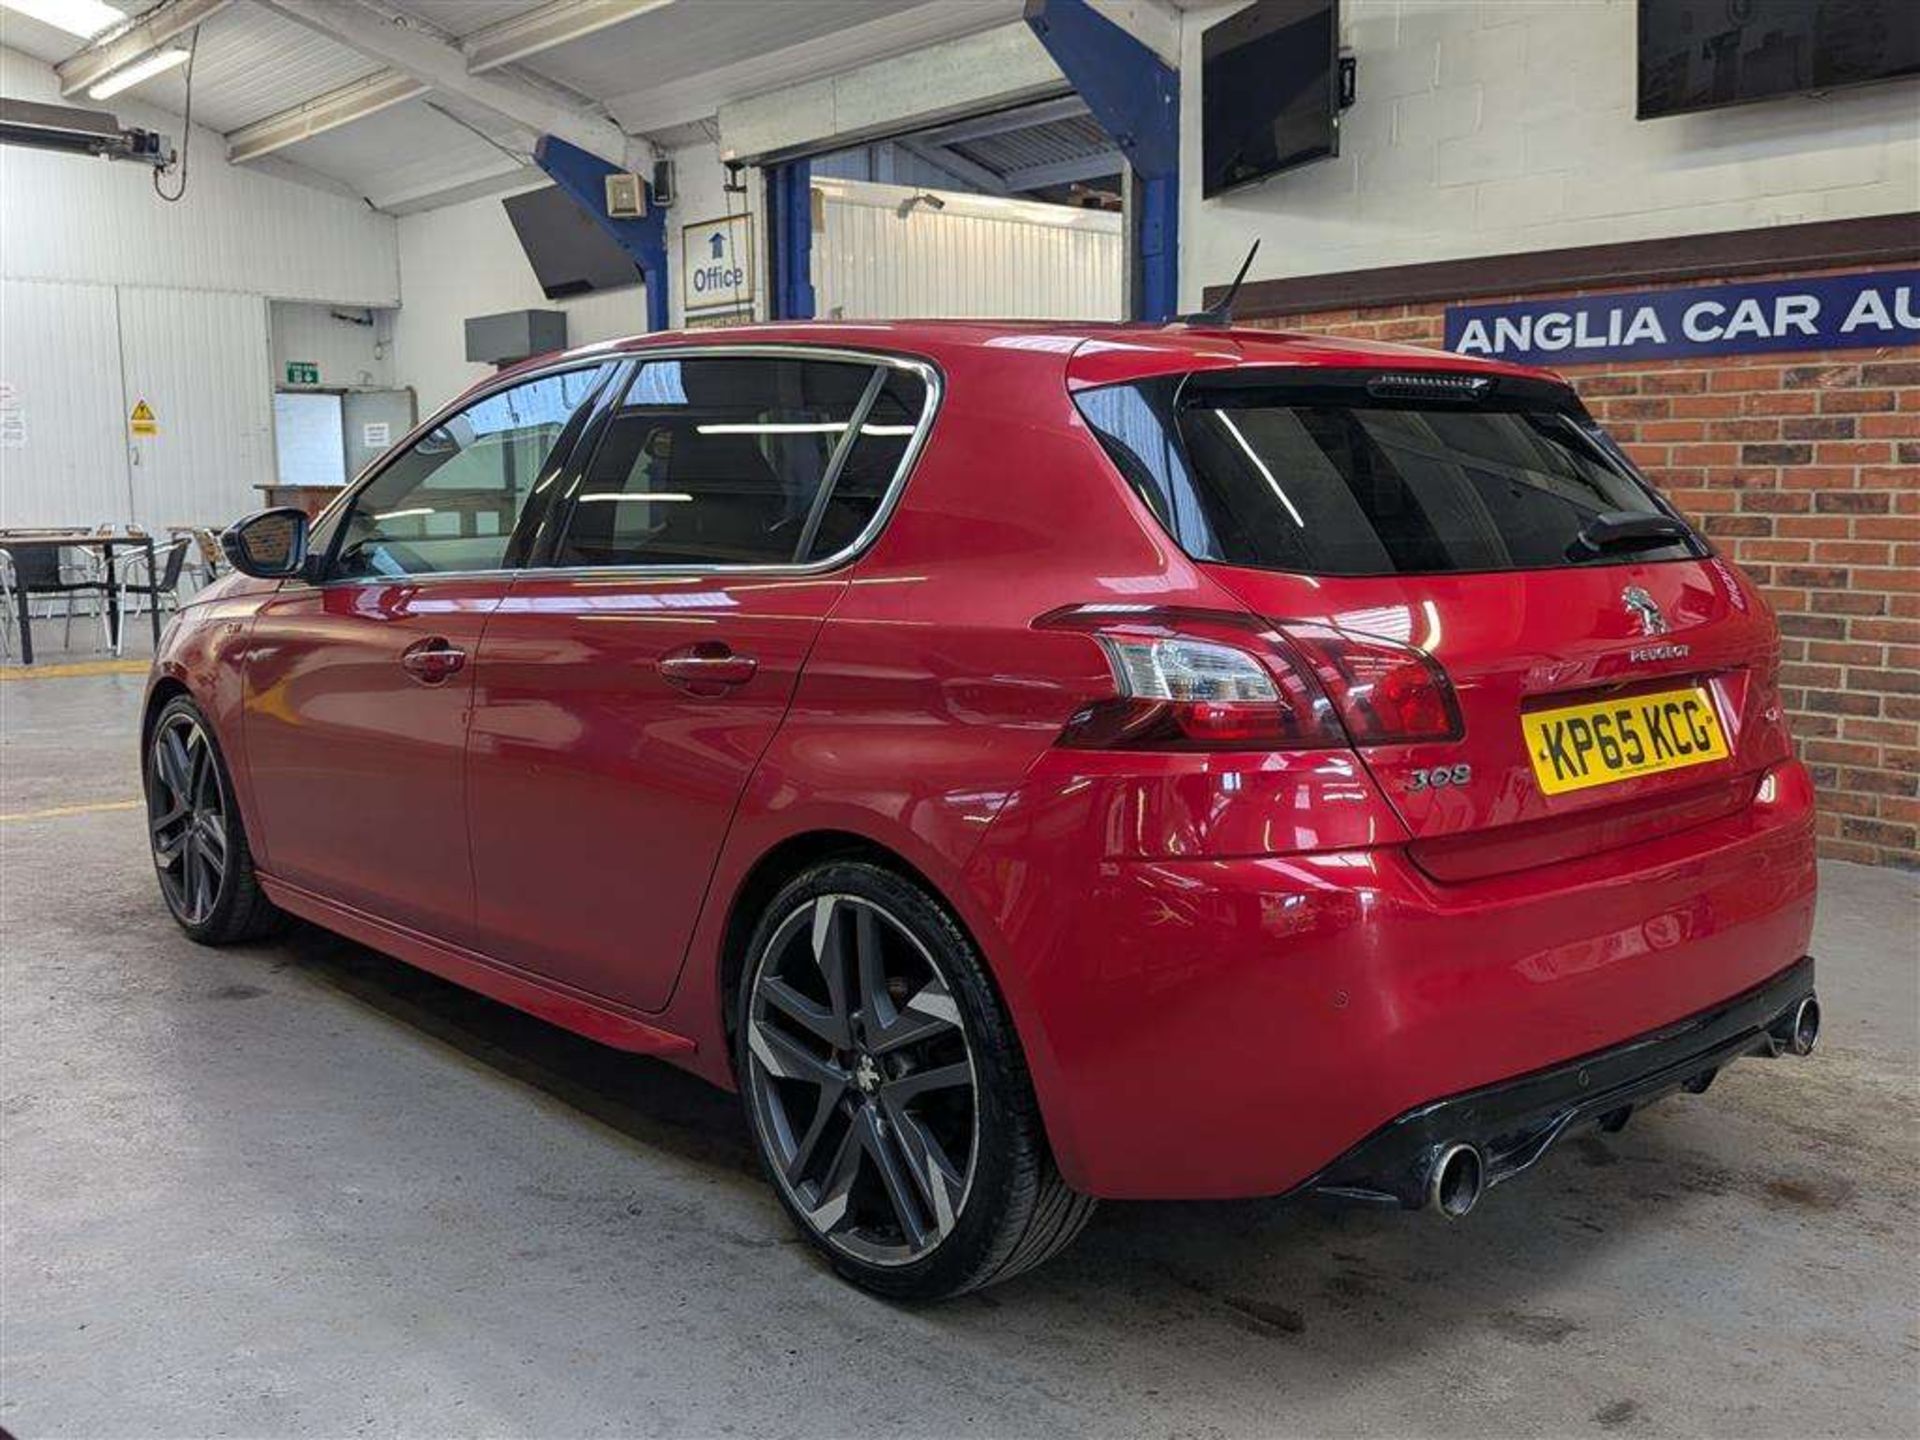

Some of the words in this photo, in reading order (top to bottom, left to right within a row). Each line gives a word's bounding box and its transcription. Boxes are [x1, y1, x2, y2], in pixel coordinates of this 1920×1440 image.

[693, 266, 743, 292] Office
[1456, 307, 1667, 354] ANGLIA
[1682, 295, 1820, 342] CAR
[1630, 644, 1690, 663] PEUGEOT
[1540, 709, 1645, 781] KP65
[1641, 700, 1711, 760] KCG
[1404, 764, 1472, 793] 308
